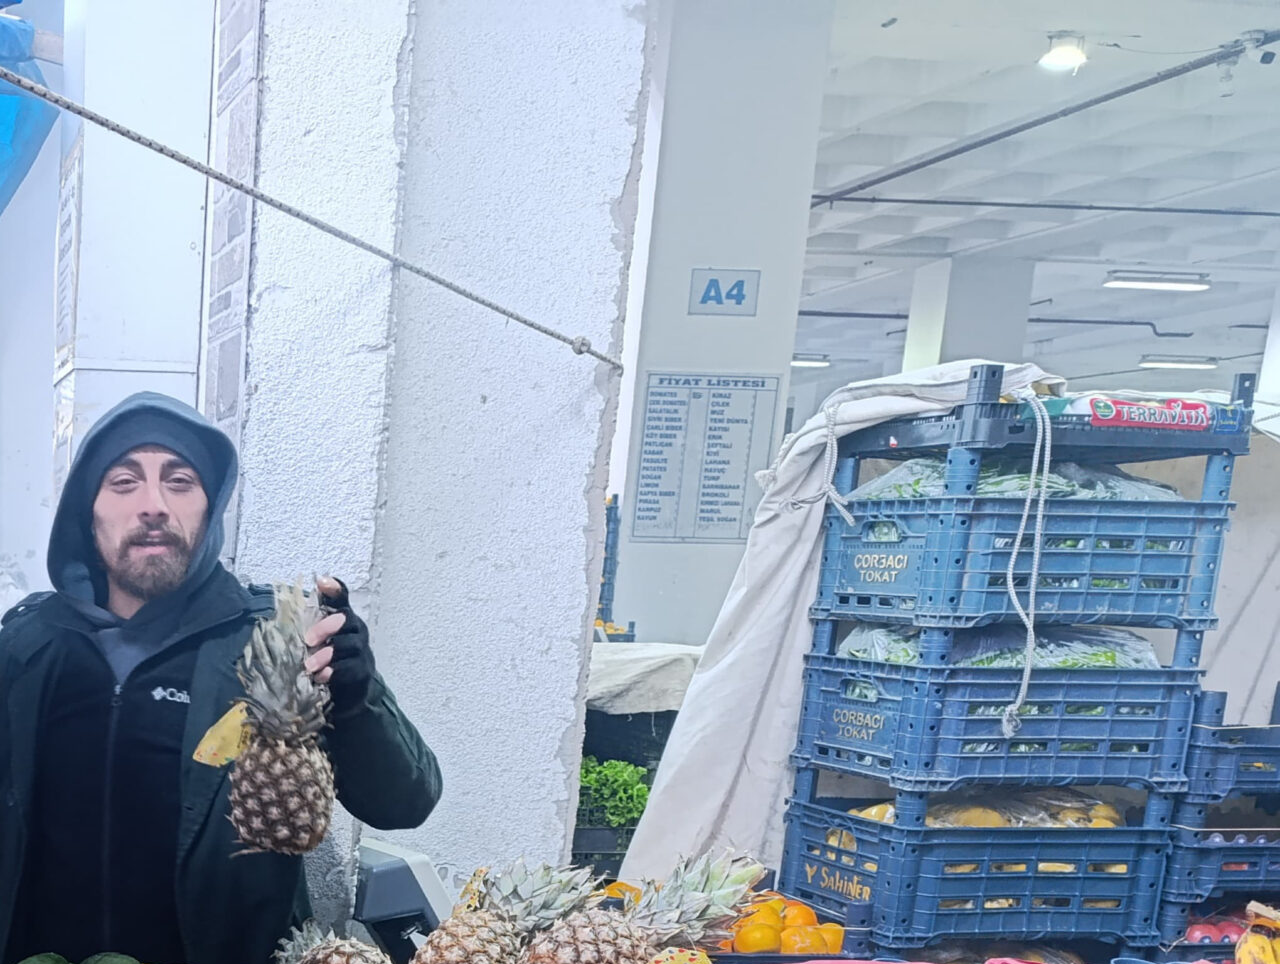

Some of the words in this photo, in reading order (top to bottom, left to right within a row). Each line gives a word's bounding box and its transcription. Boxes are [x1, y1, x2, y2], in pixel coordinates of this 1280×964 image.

[699, 278, 746, 305] A4
[658, 377, 702, 386] FİYAT
[706, 378, 766, 388] LİSTESİ
[1117, 402, 1208, 425] TERRAVITA
[859, 570, 899, 583] TOKAT
[837, 725, 877, 741] TOKAT
